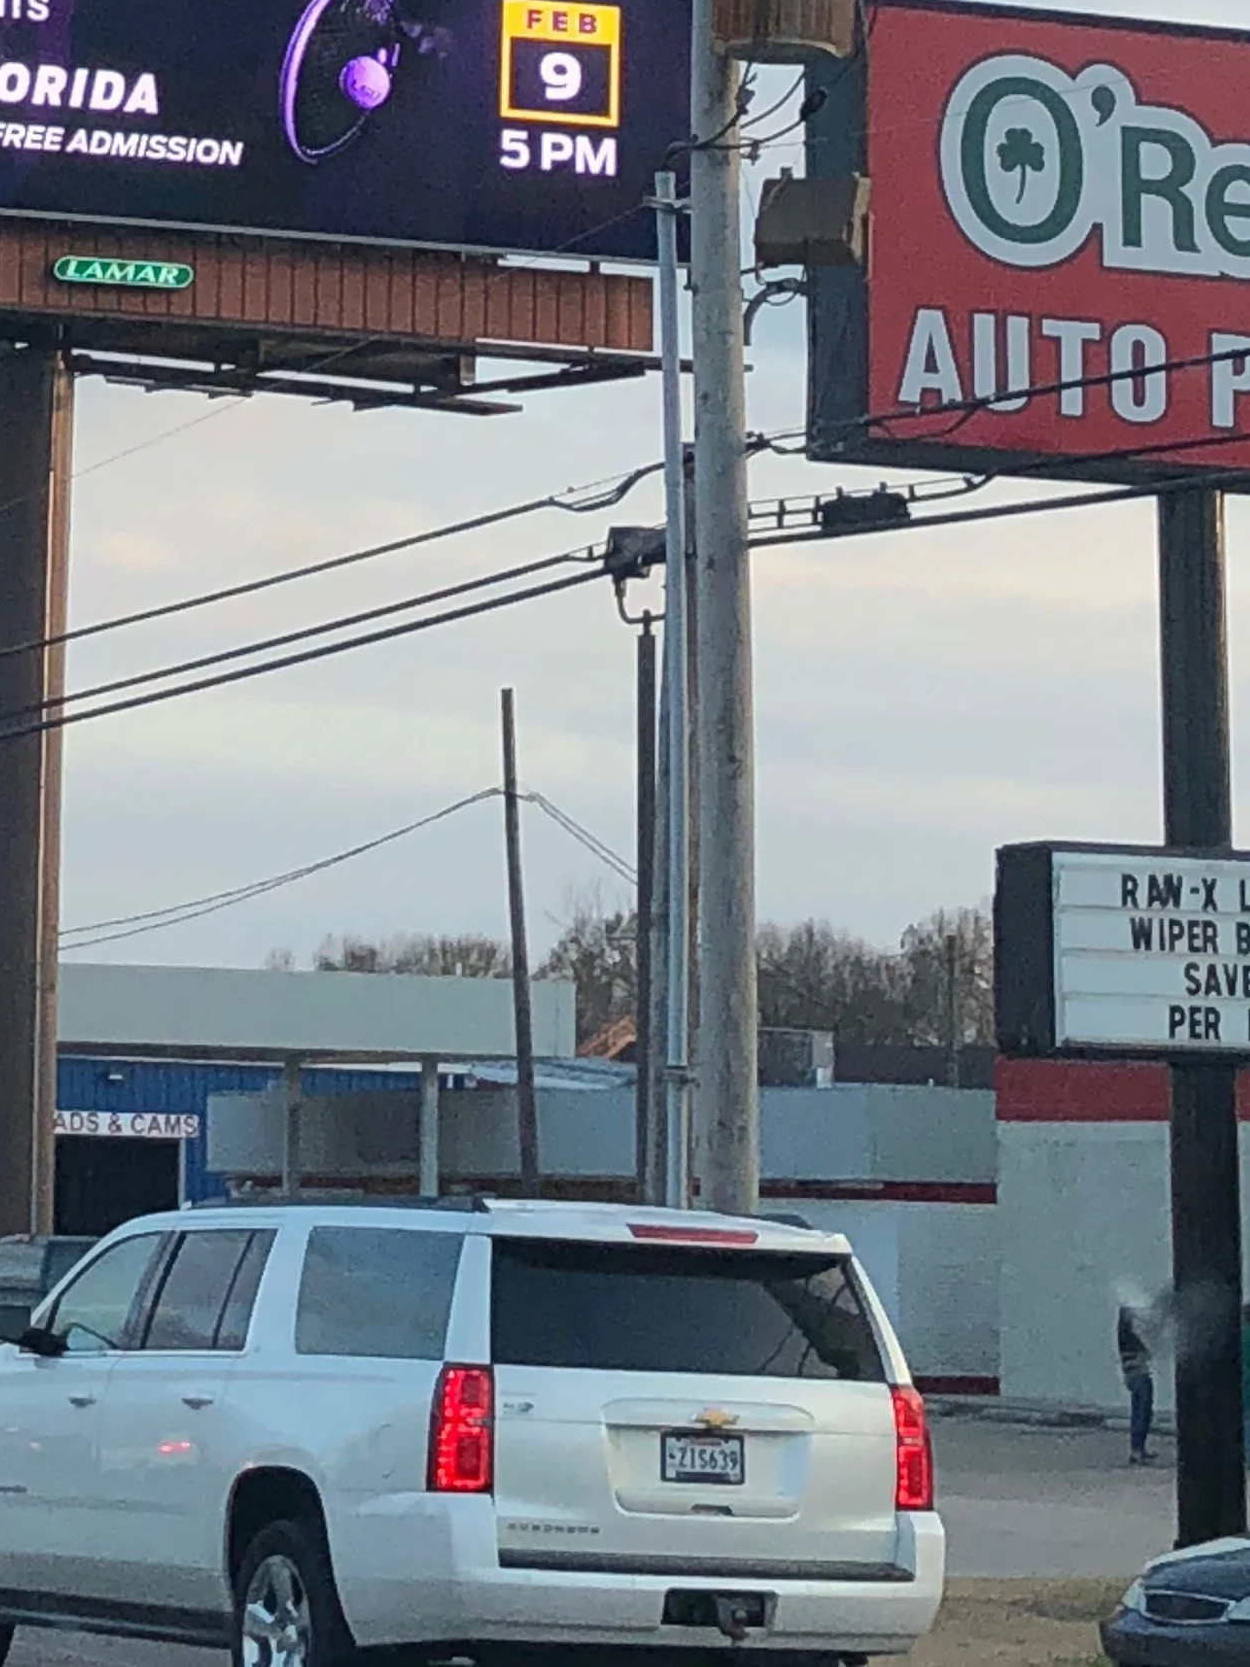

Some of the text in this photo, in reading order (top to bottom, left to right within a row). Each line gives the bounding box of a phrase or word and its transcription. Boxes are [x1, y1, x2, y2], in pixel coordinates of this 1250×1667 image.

[526, 9, 598, 34] FEB
[540, 52, 582, 101] 9
[66, 129, 244, 166] ADMISSION
[500, 129, 617, 177] 5 PM
[65, 259, 180, 285] LAMAR
[898, 308, 1167, 423] AUTO
[1130, 917, 1219, 955] WIPER
[1169, 1005, 1221, 1040] PER
[108, 1112, 122, 1134] &
[131, 1113, 196, 1136] CAMS
